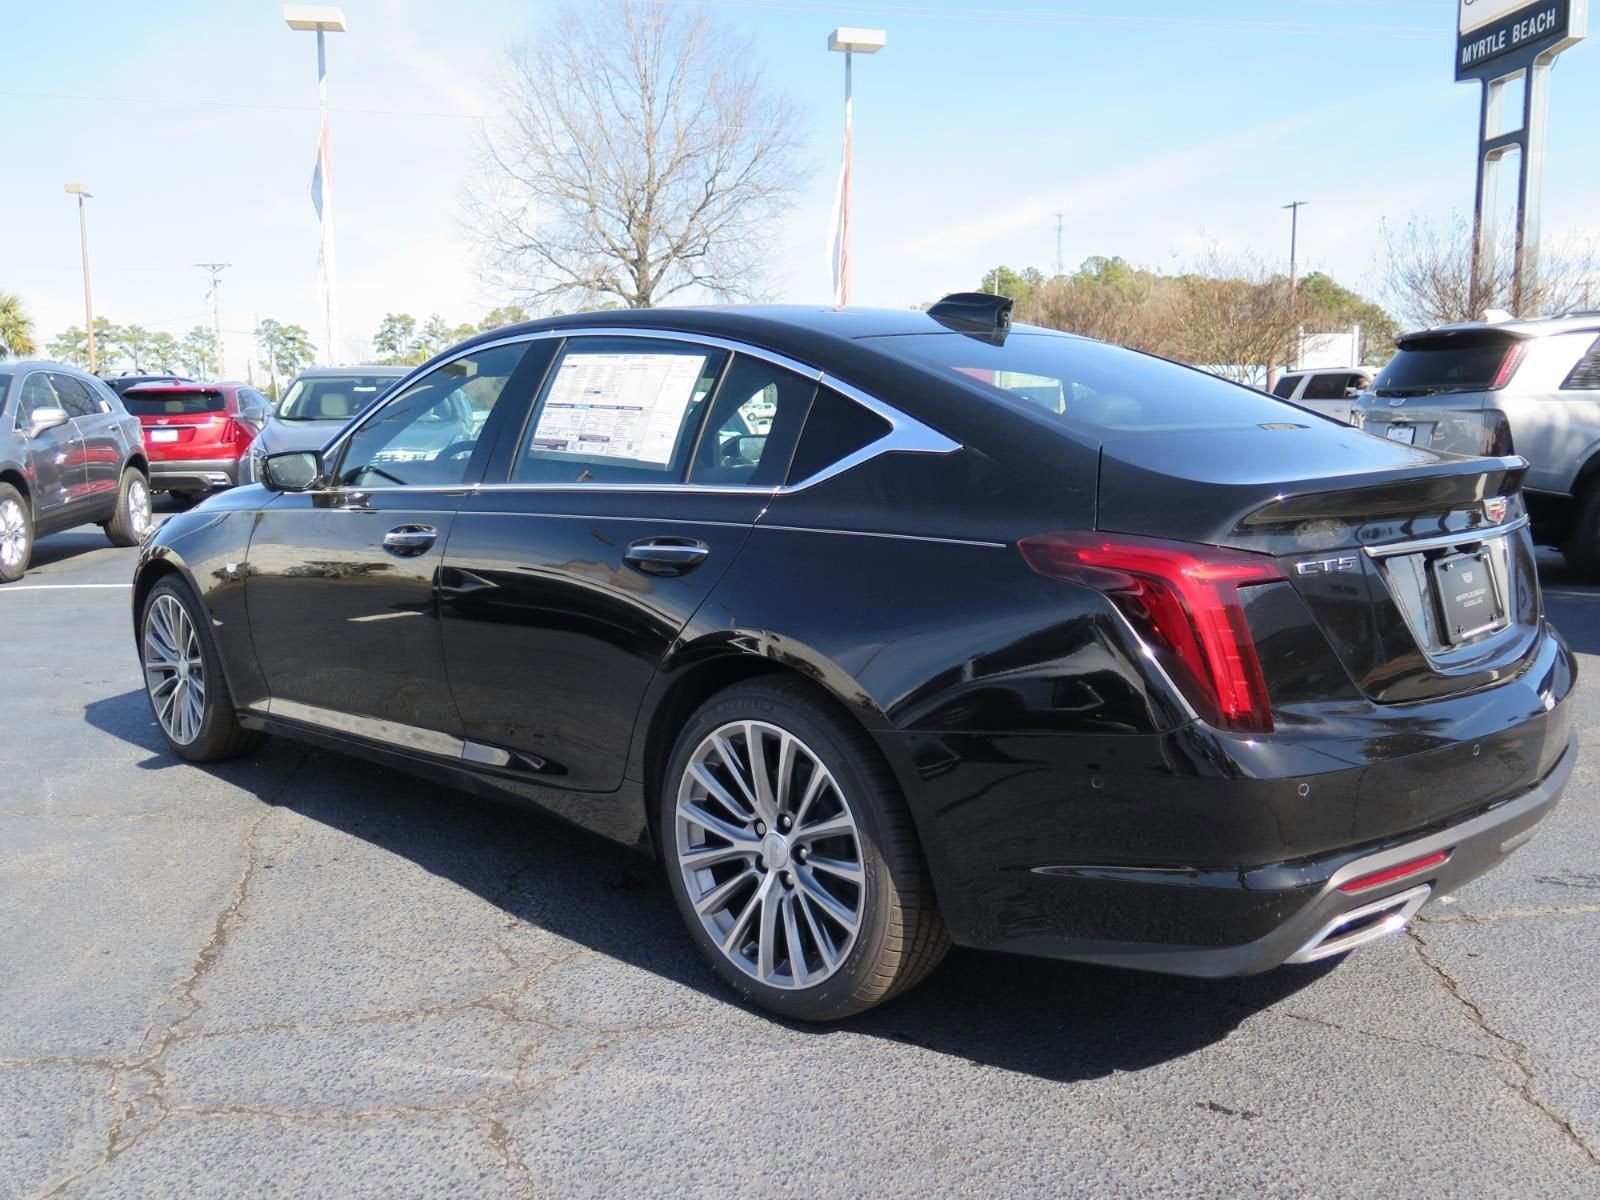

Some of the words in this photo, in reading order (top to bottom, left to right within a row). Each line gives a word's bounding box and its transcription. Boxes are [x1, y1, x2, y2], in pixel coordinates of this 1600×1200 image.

[1462, 29, 1506, 64] MYRTLE
[1512, 8, 1556, 44] BEACH
[1295, 556, 1357, 574] CT5
